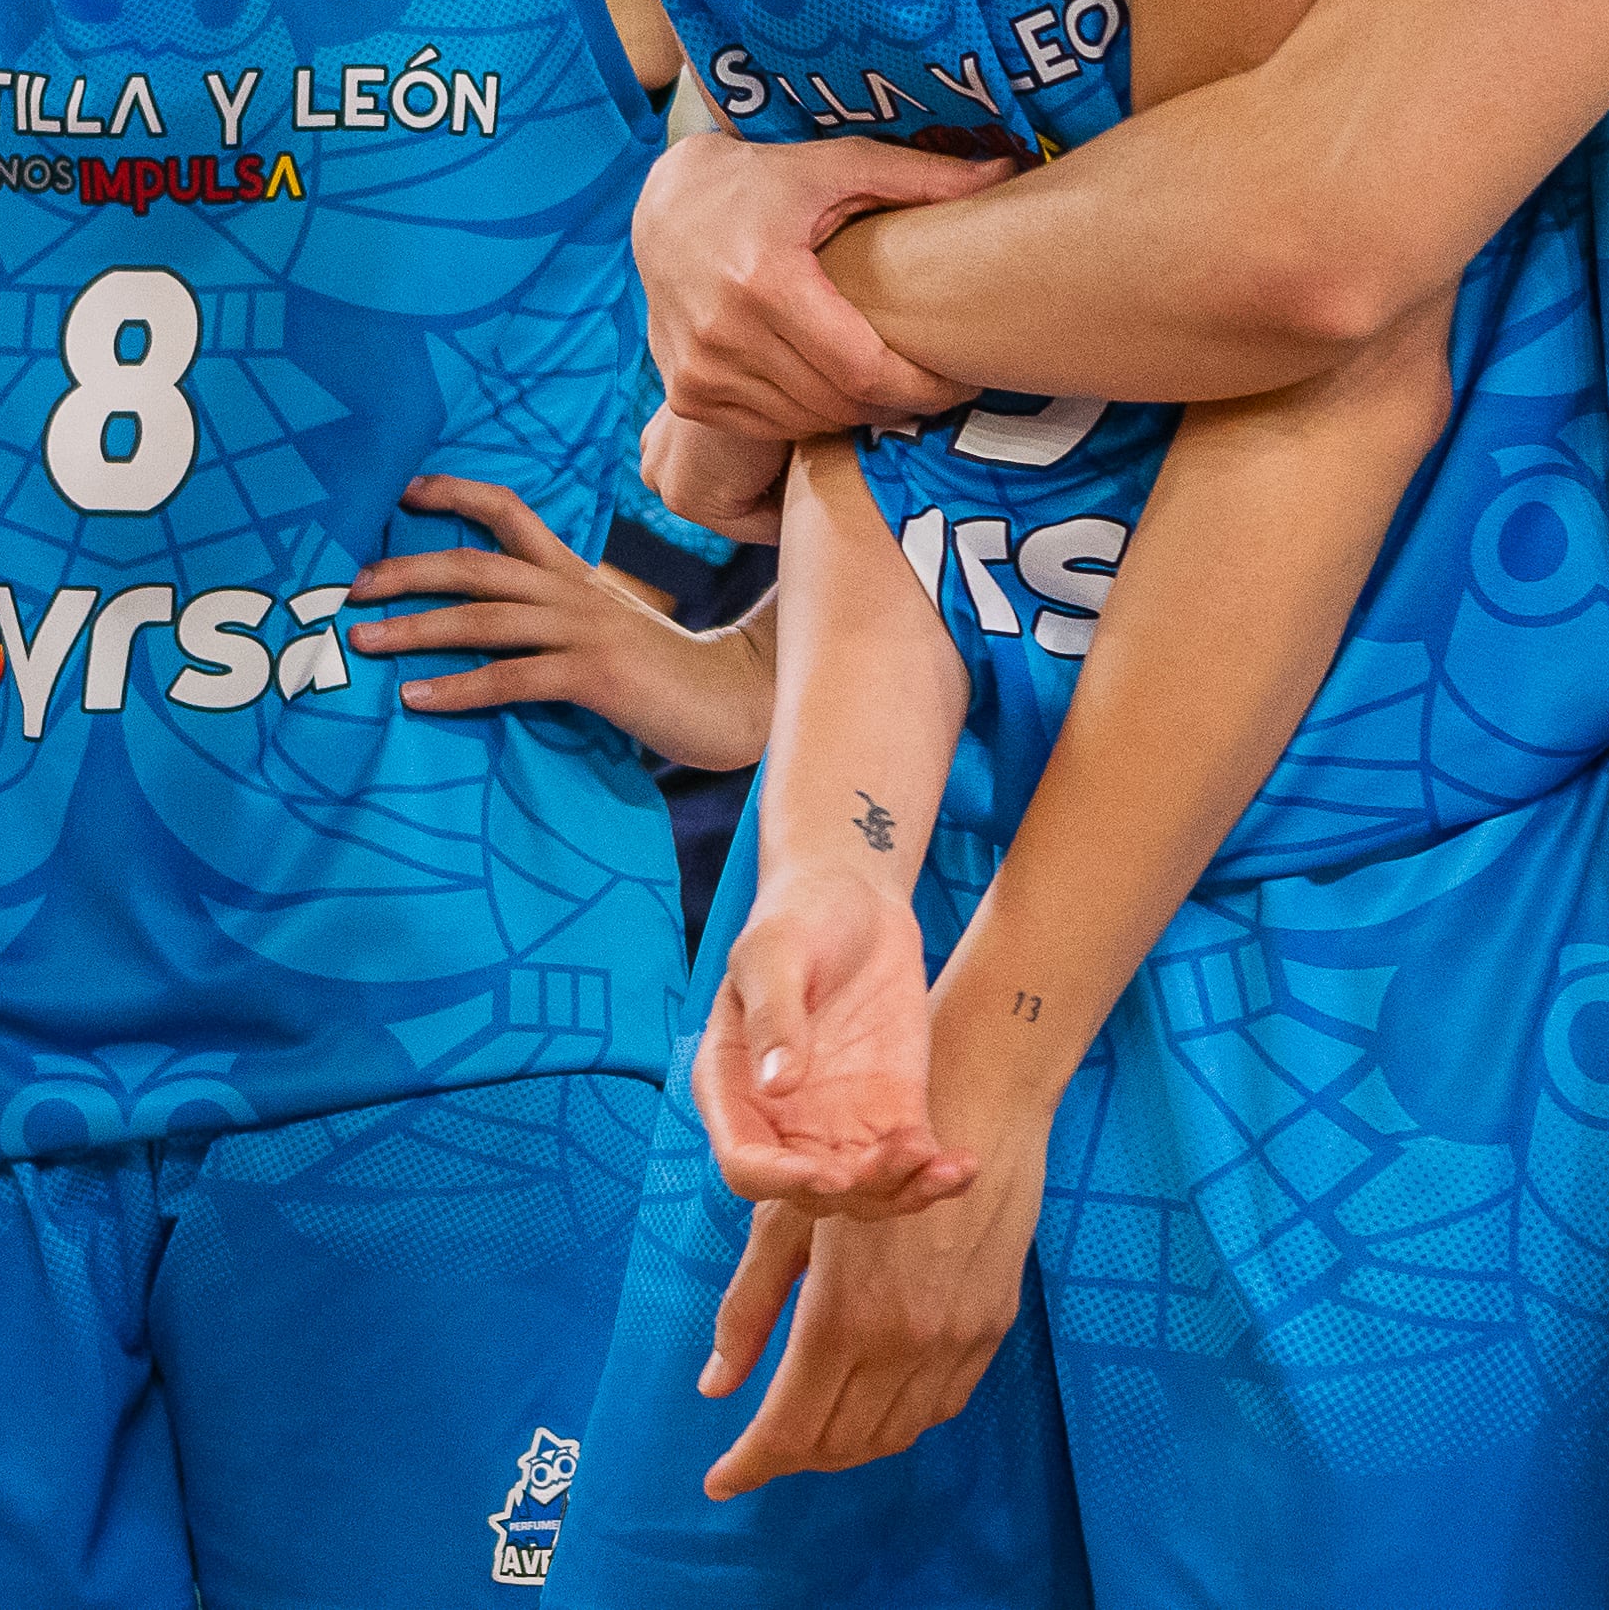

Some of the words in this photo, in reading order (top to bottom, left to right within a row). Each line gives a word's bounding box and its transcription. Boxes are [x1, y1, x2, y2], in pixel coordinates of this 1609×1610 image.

[206, 70, 260, 147] Y
[296, 45, 498, 136] LEÓN
[44, 268, 200, 515] 8
[1012, 991, 1043, 1022] 13
